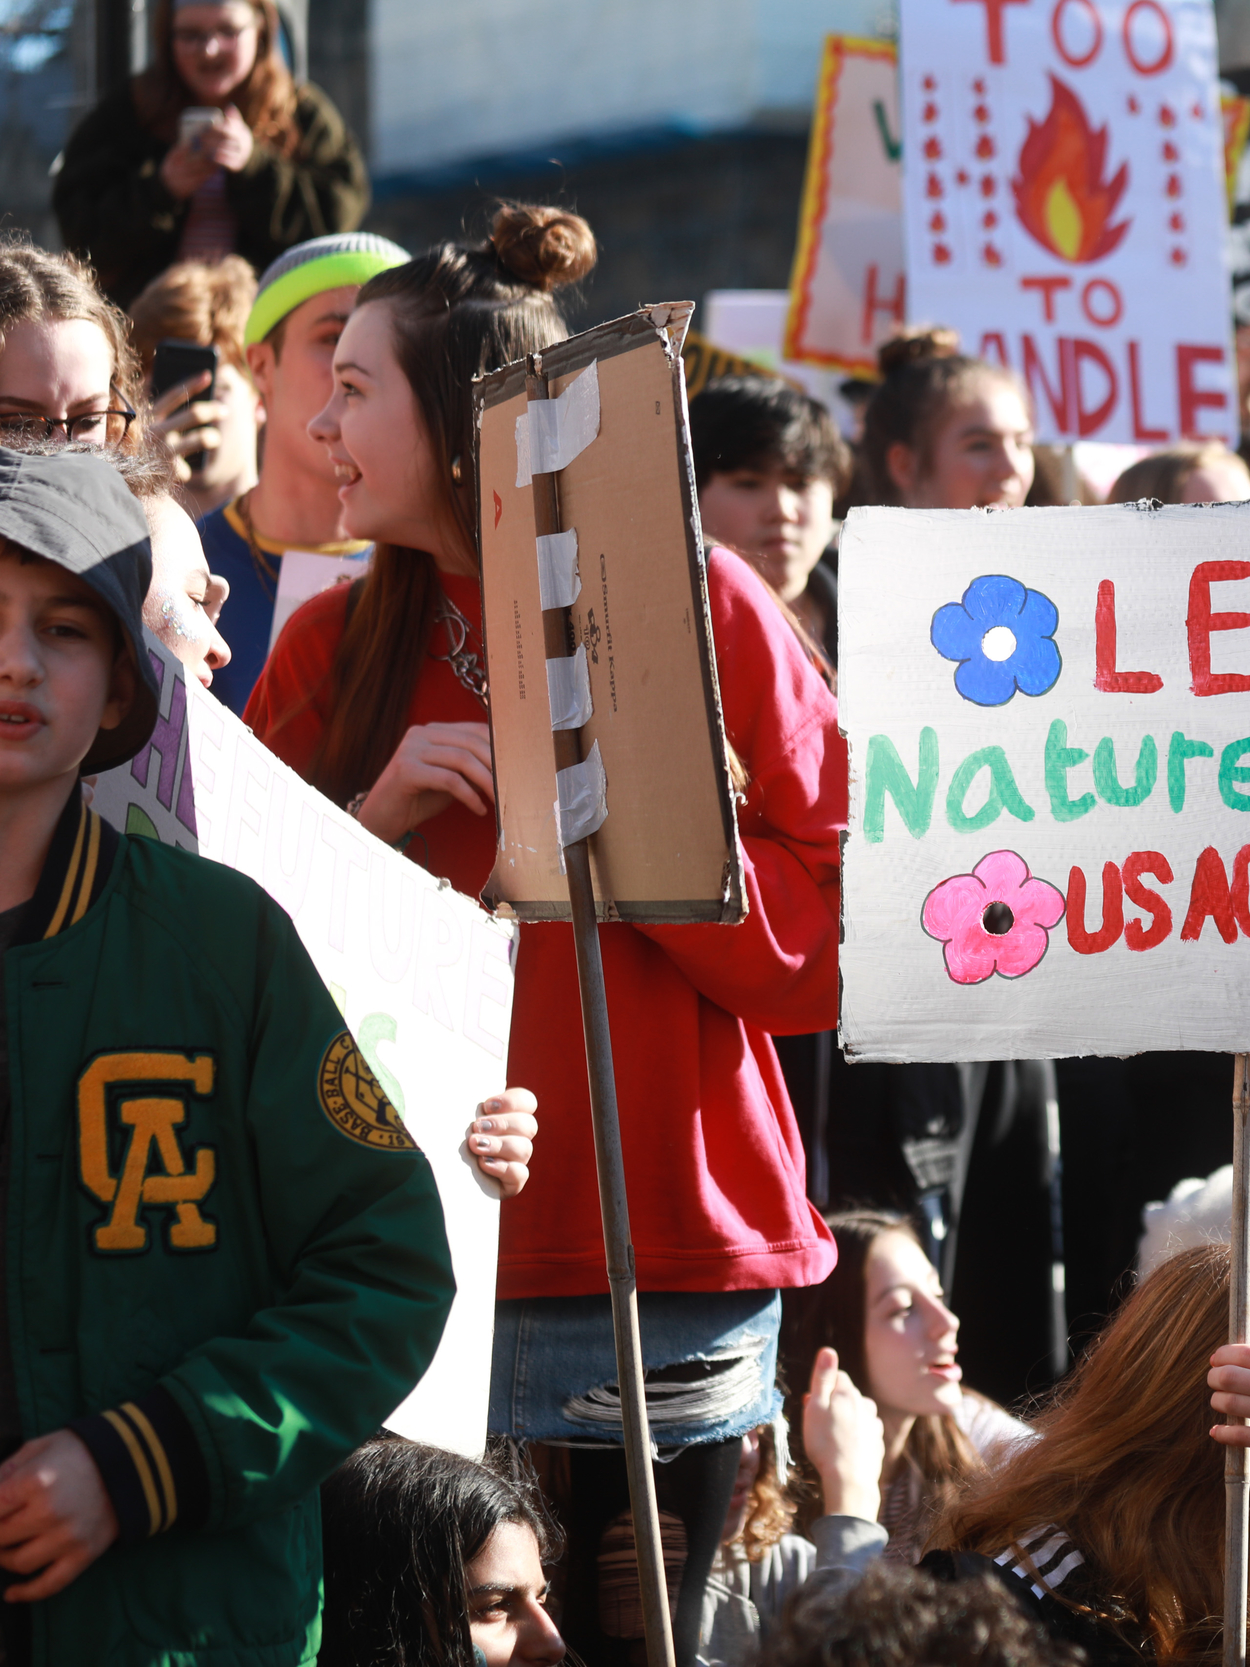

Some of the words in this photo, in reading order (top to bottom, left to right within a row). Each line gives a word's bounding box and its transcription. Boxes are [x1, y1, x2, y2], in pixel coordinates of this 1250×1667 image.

[945, 0, 1174, 77] TOO
[1021, 275, 1124, 327] TO
[602, 584, 612, 651] Smurfit
[608, 656, 617, 712] Kappa
